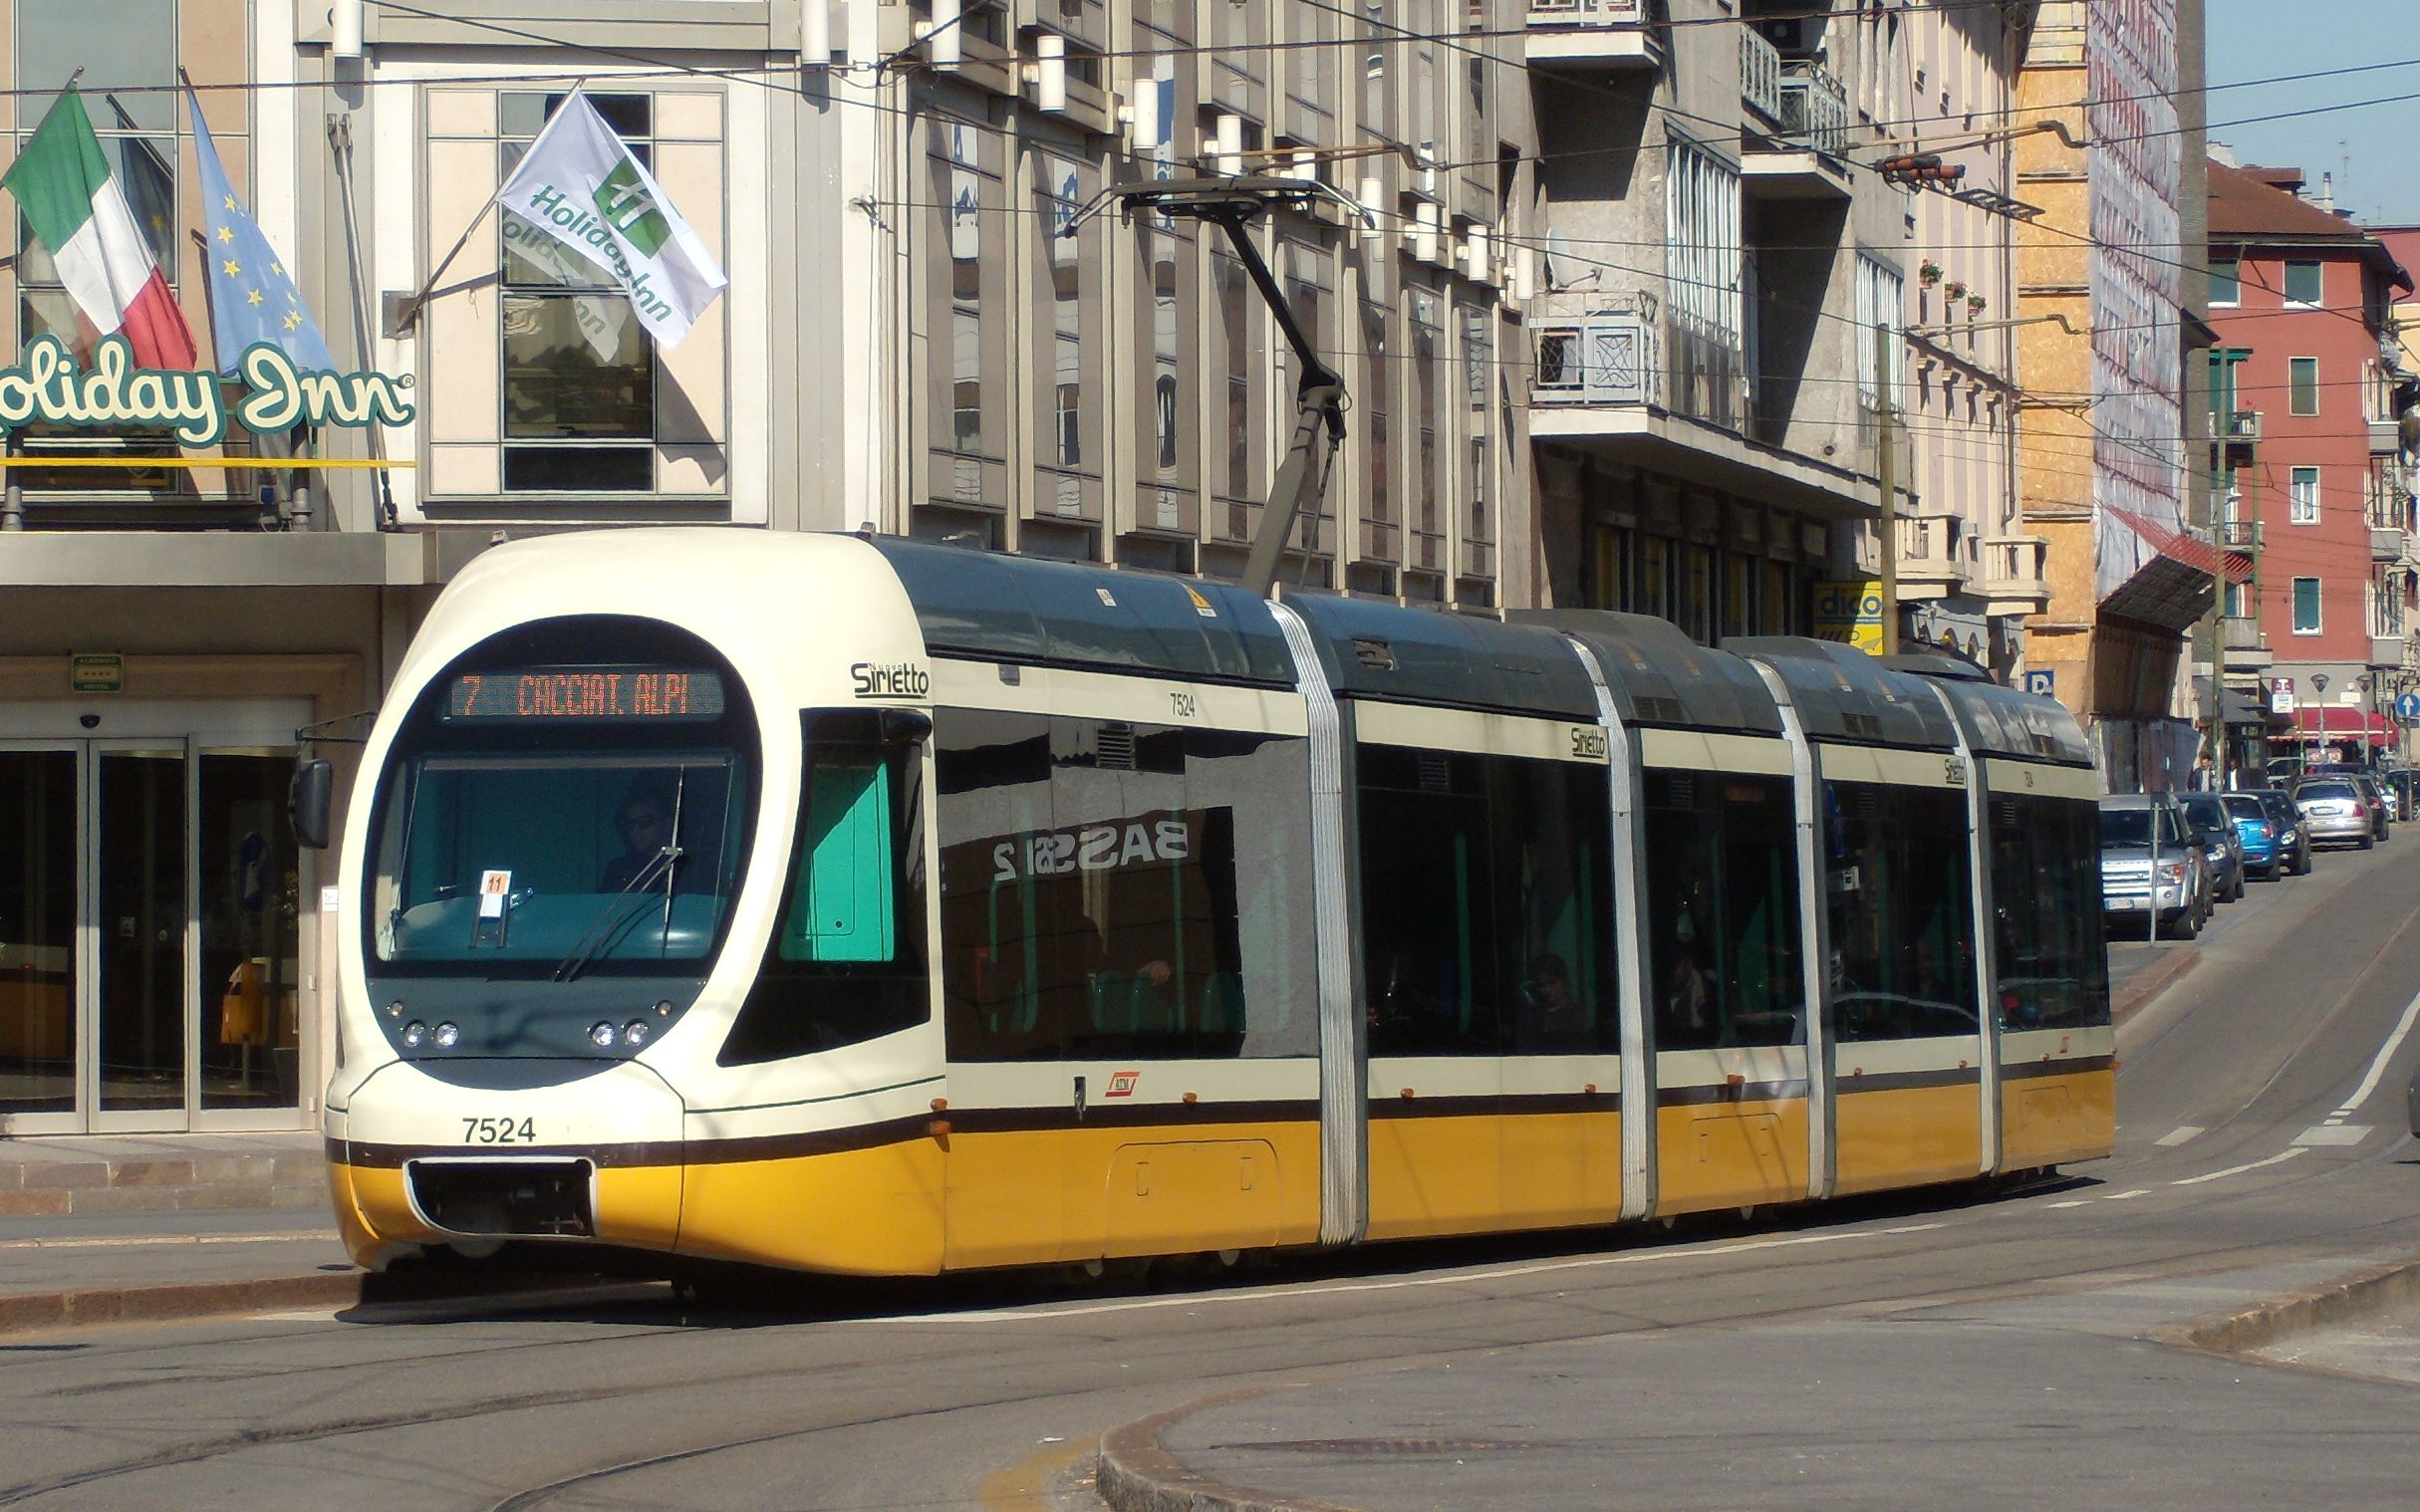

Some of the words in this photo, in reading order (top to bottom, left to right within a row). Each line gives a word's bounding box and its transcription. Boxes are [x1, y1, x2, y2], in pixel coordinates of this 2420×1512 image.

[529, 183, 632, 279] Holiday
[632, 272, 672, 323] Inn
[0, 340, 218, 443] oliday
[1818, 586, 1883, 616] dico
[850, 661, 930, 694] Sirietto
[461, 674, 481, 716] 7
[634, 673, 687, 716] ALPI
[1169, 692, 1196, 718] 7524
[462, 1117, 537, 1143] 7524
